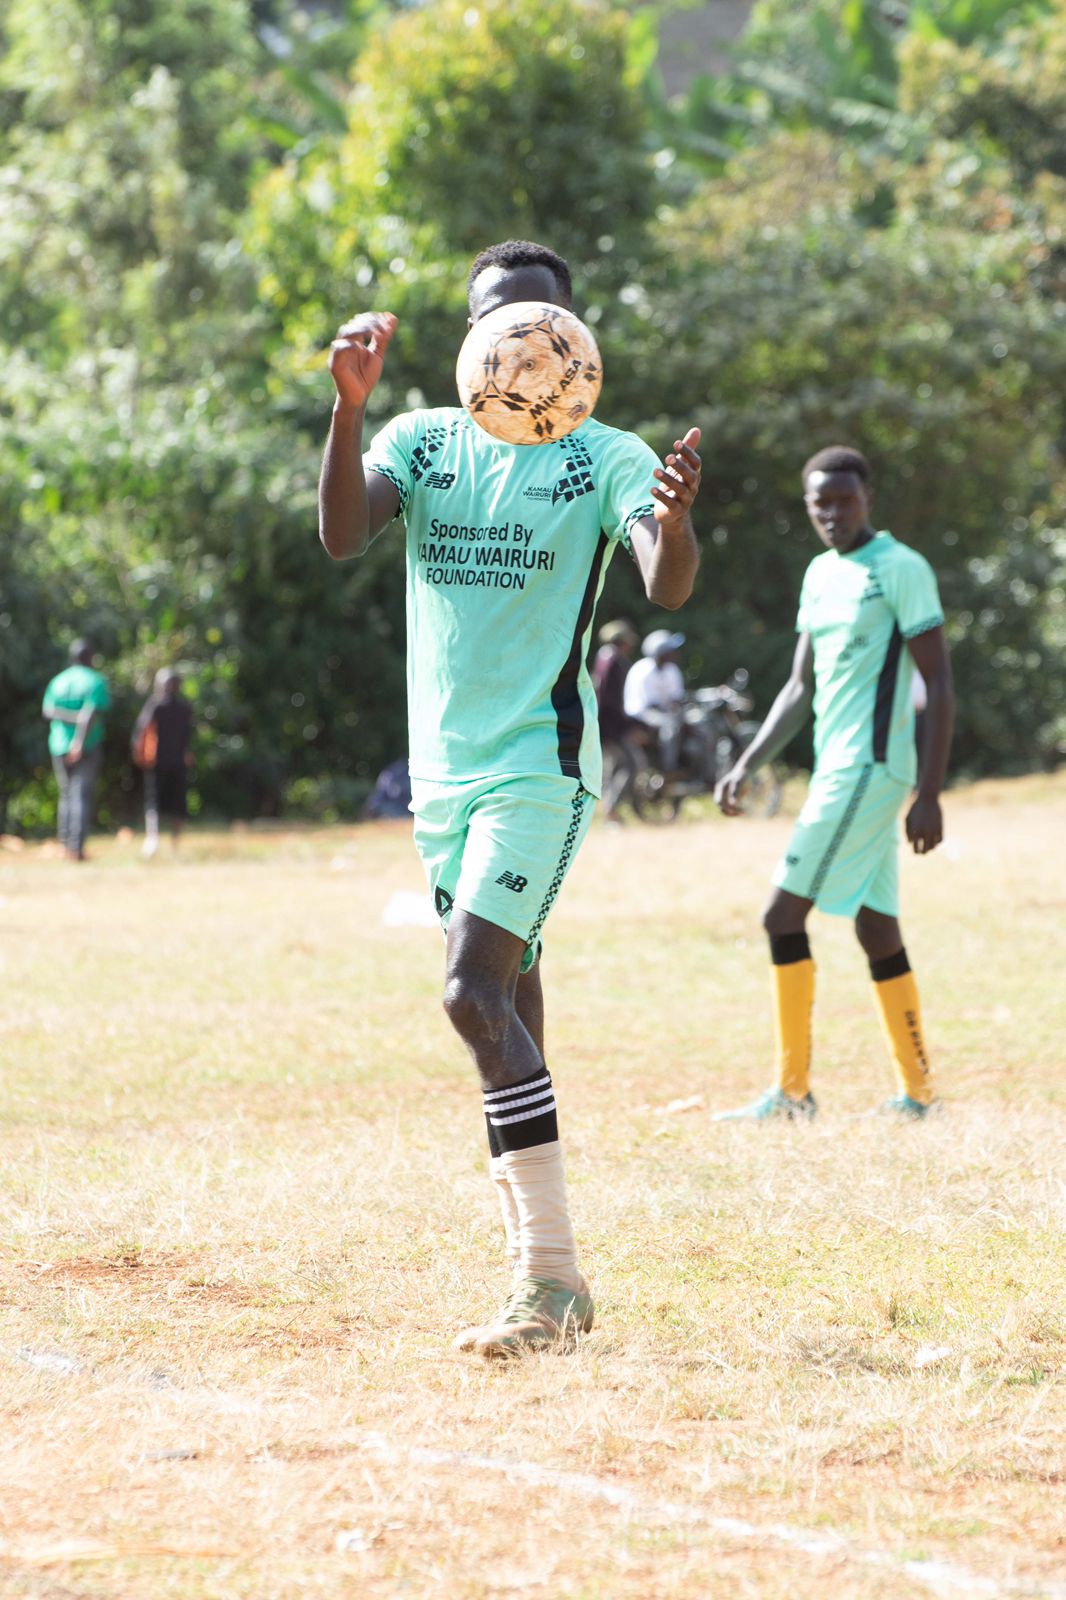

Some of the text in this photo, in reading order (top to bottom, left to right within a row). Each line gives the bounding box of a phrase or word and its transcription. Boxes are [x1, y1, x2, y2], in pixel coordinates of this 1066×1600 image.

[429, 518, 533, 547] Sponsored By
[475, 547, 555, 571] WAIRURI
[426, 567, 526, 590] FOUNDATION
